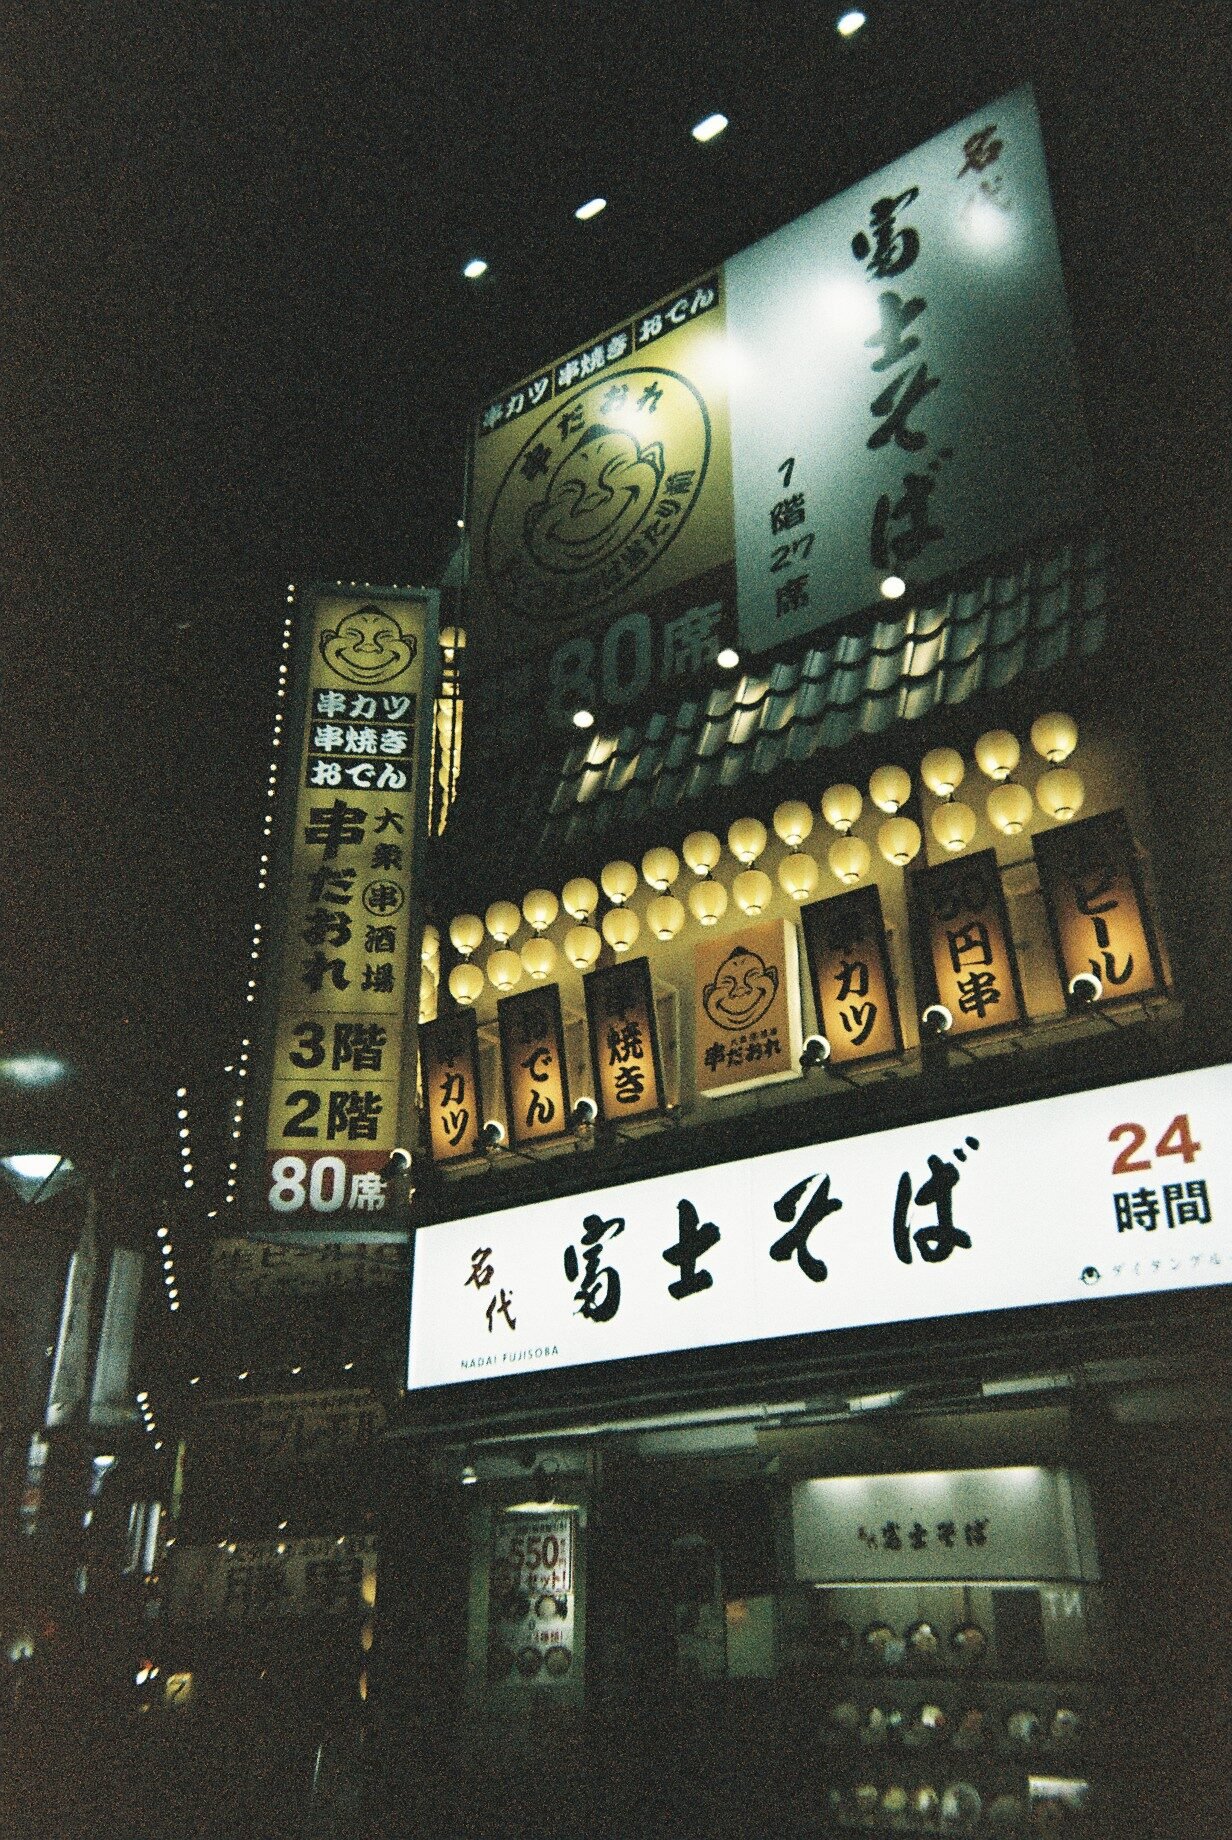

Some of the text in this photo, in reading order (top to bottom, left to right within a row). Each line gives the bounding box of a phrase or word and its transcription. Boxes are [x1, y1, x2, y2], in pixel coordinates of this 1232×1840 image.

[639, 287, 716, 342] おでん
[557, 332, 629, 387] 串焼き
[851, 186, 951, 573] 富士そば
[481, 376, 550, 430] 串カツ
[316, 690, 411, 719] 串カツ
[313, 723, 409, 756] 串焼き
[310, 759, 408, 789] おでん
[303, 798, 368, 995] 串だおれ
[830, 938, 878, 1046] カツ
[288, 1021, 388, 1072] 3階
[606, 1008, 646, 1104] 焼き
[282, 1089, 383, 1142] 2階
[439, 1052, 470, 1147] カツ
[1108, 1114, 1202, 1176] 24
[268, 1155, 388, 1213] 80席
[1112, 1179, 1213, 1233] 時間
[563, 1136, 980, 1323] 富士そば
[464, 1246, 517, 1333] 名代
[460, 1345, 560, 1369] NADAI FUJISOBA
